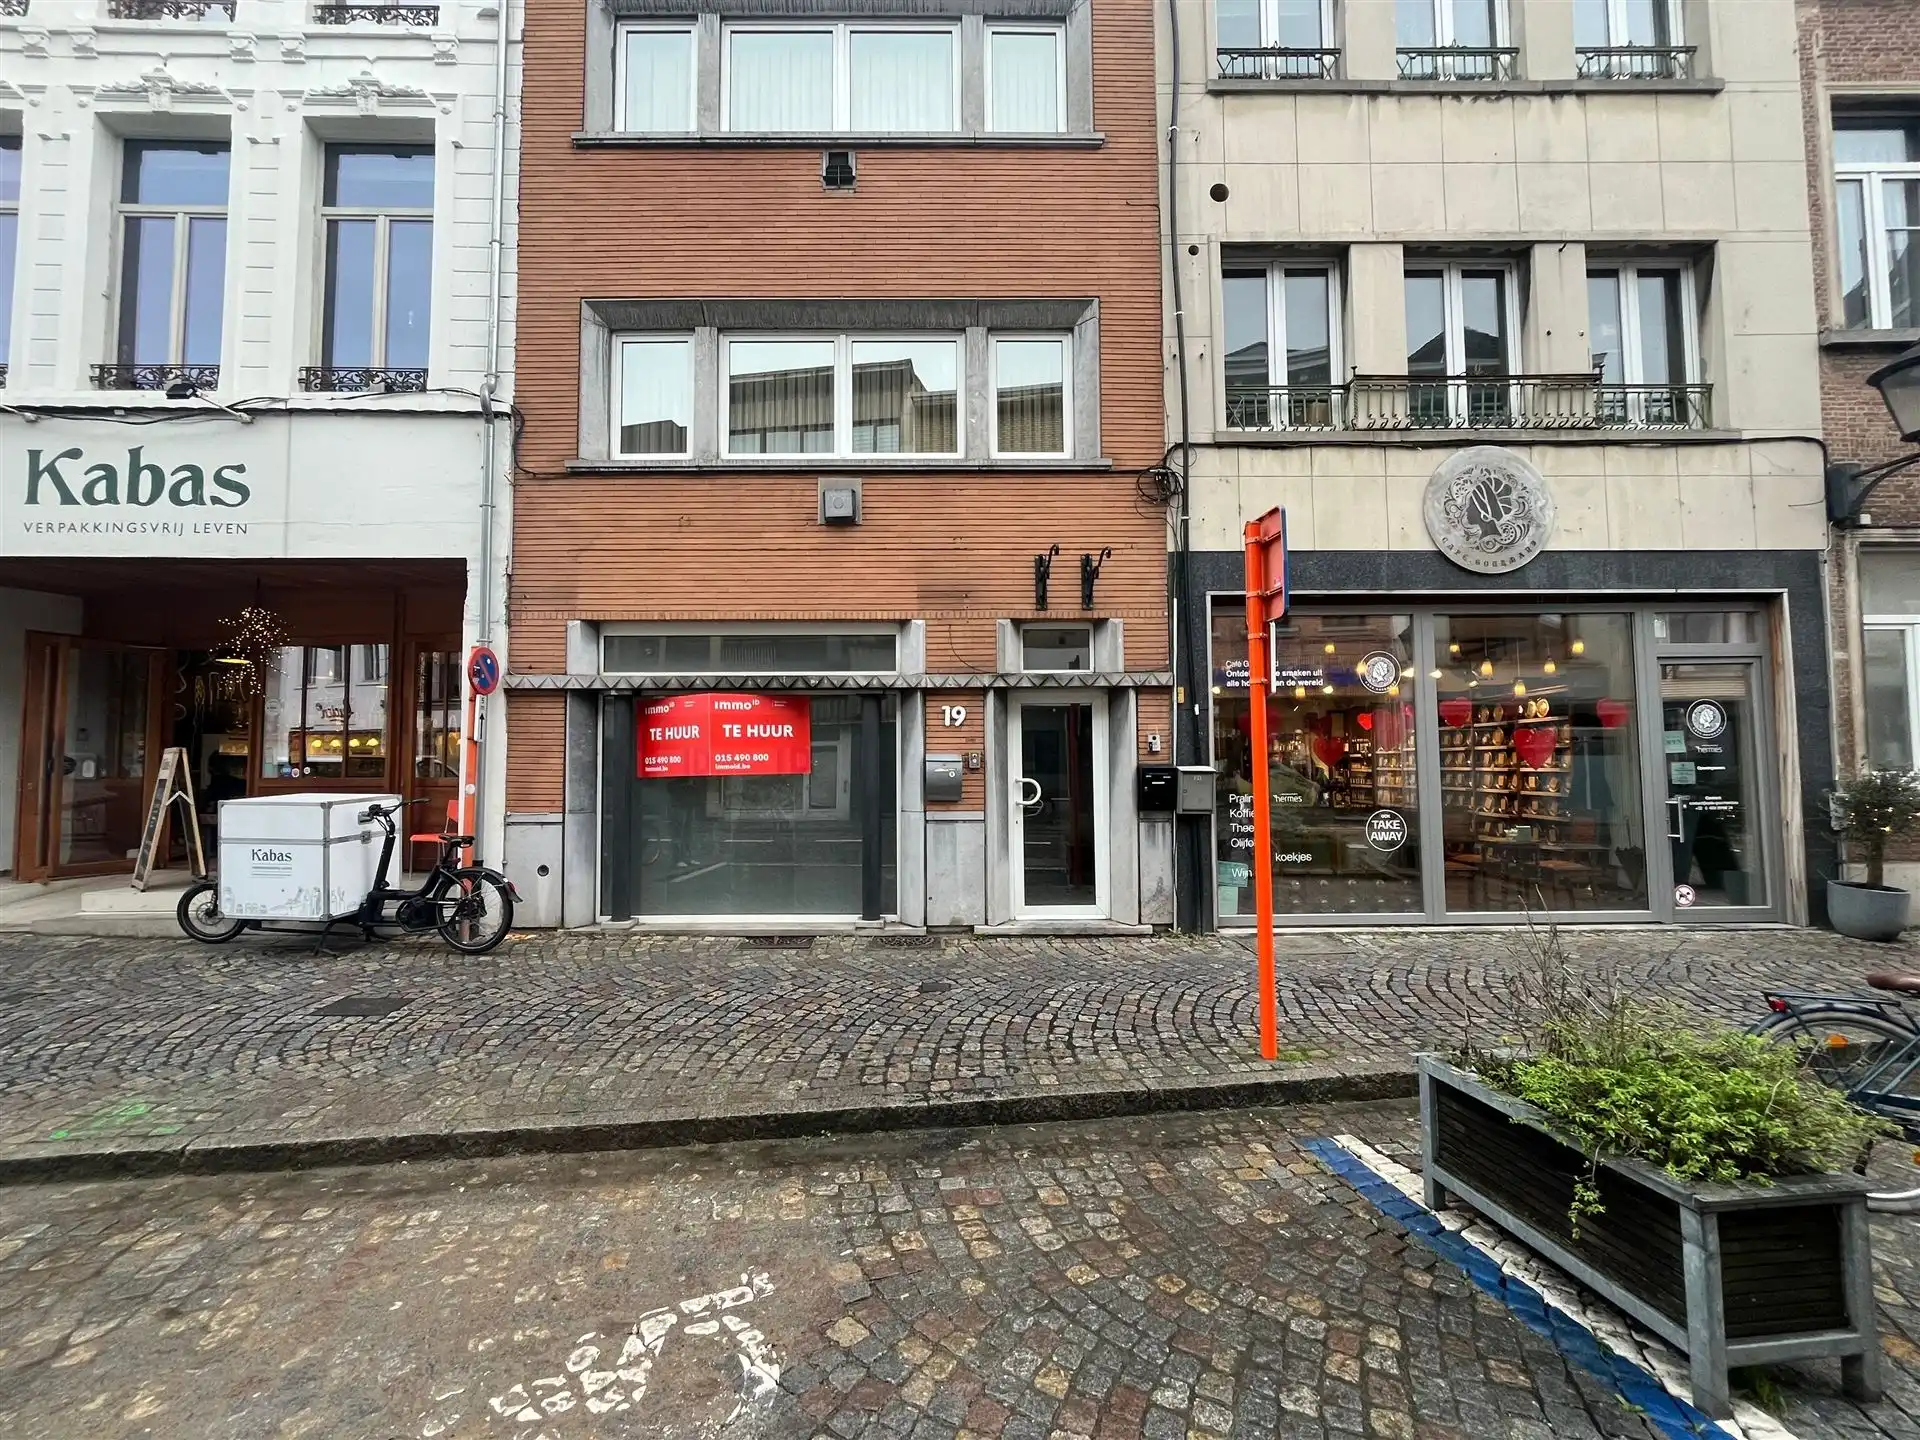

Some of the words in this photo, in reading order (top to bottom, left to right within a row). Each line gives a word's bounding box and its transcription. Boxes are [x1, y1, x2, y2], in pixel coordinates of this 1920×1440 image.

[24, 445, 250, 507] Kabas
[24, 522, 184, 536] VERPAKKINGSVRIJ
[193, 523, 248, 535] LEVEN
[1313, 669, 1323, 677] uit
[1286, 679, 1296, 687] de
[1297, 679, 1324, 687] wereld
[941, 705, 967, 727] 19
[650, 728, 662, 741] TE
[665, 725, 700, 740] HUUR
[722, 724, 742, 738] TE
[747, 724, 794, 738] HUUR
[644, 757, 656, 765] 015
[657, 756, 668, 764] 490
[669, 755, 682, 764] 800
[715, 754, 732, 762] 015
[734, 754, 751, 762] 490
[752, 753, 769, 762] 800
[1230, 823, 1254, 832] Thee
[1371, 820, 1401, 830] TAKE
[1370, 832, 1403, 841] AWAY
[252, 848, 293, 862] Kabas
[1275, 852, 1312, 863] koekjes
